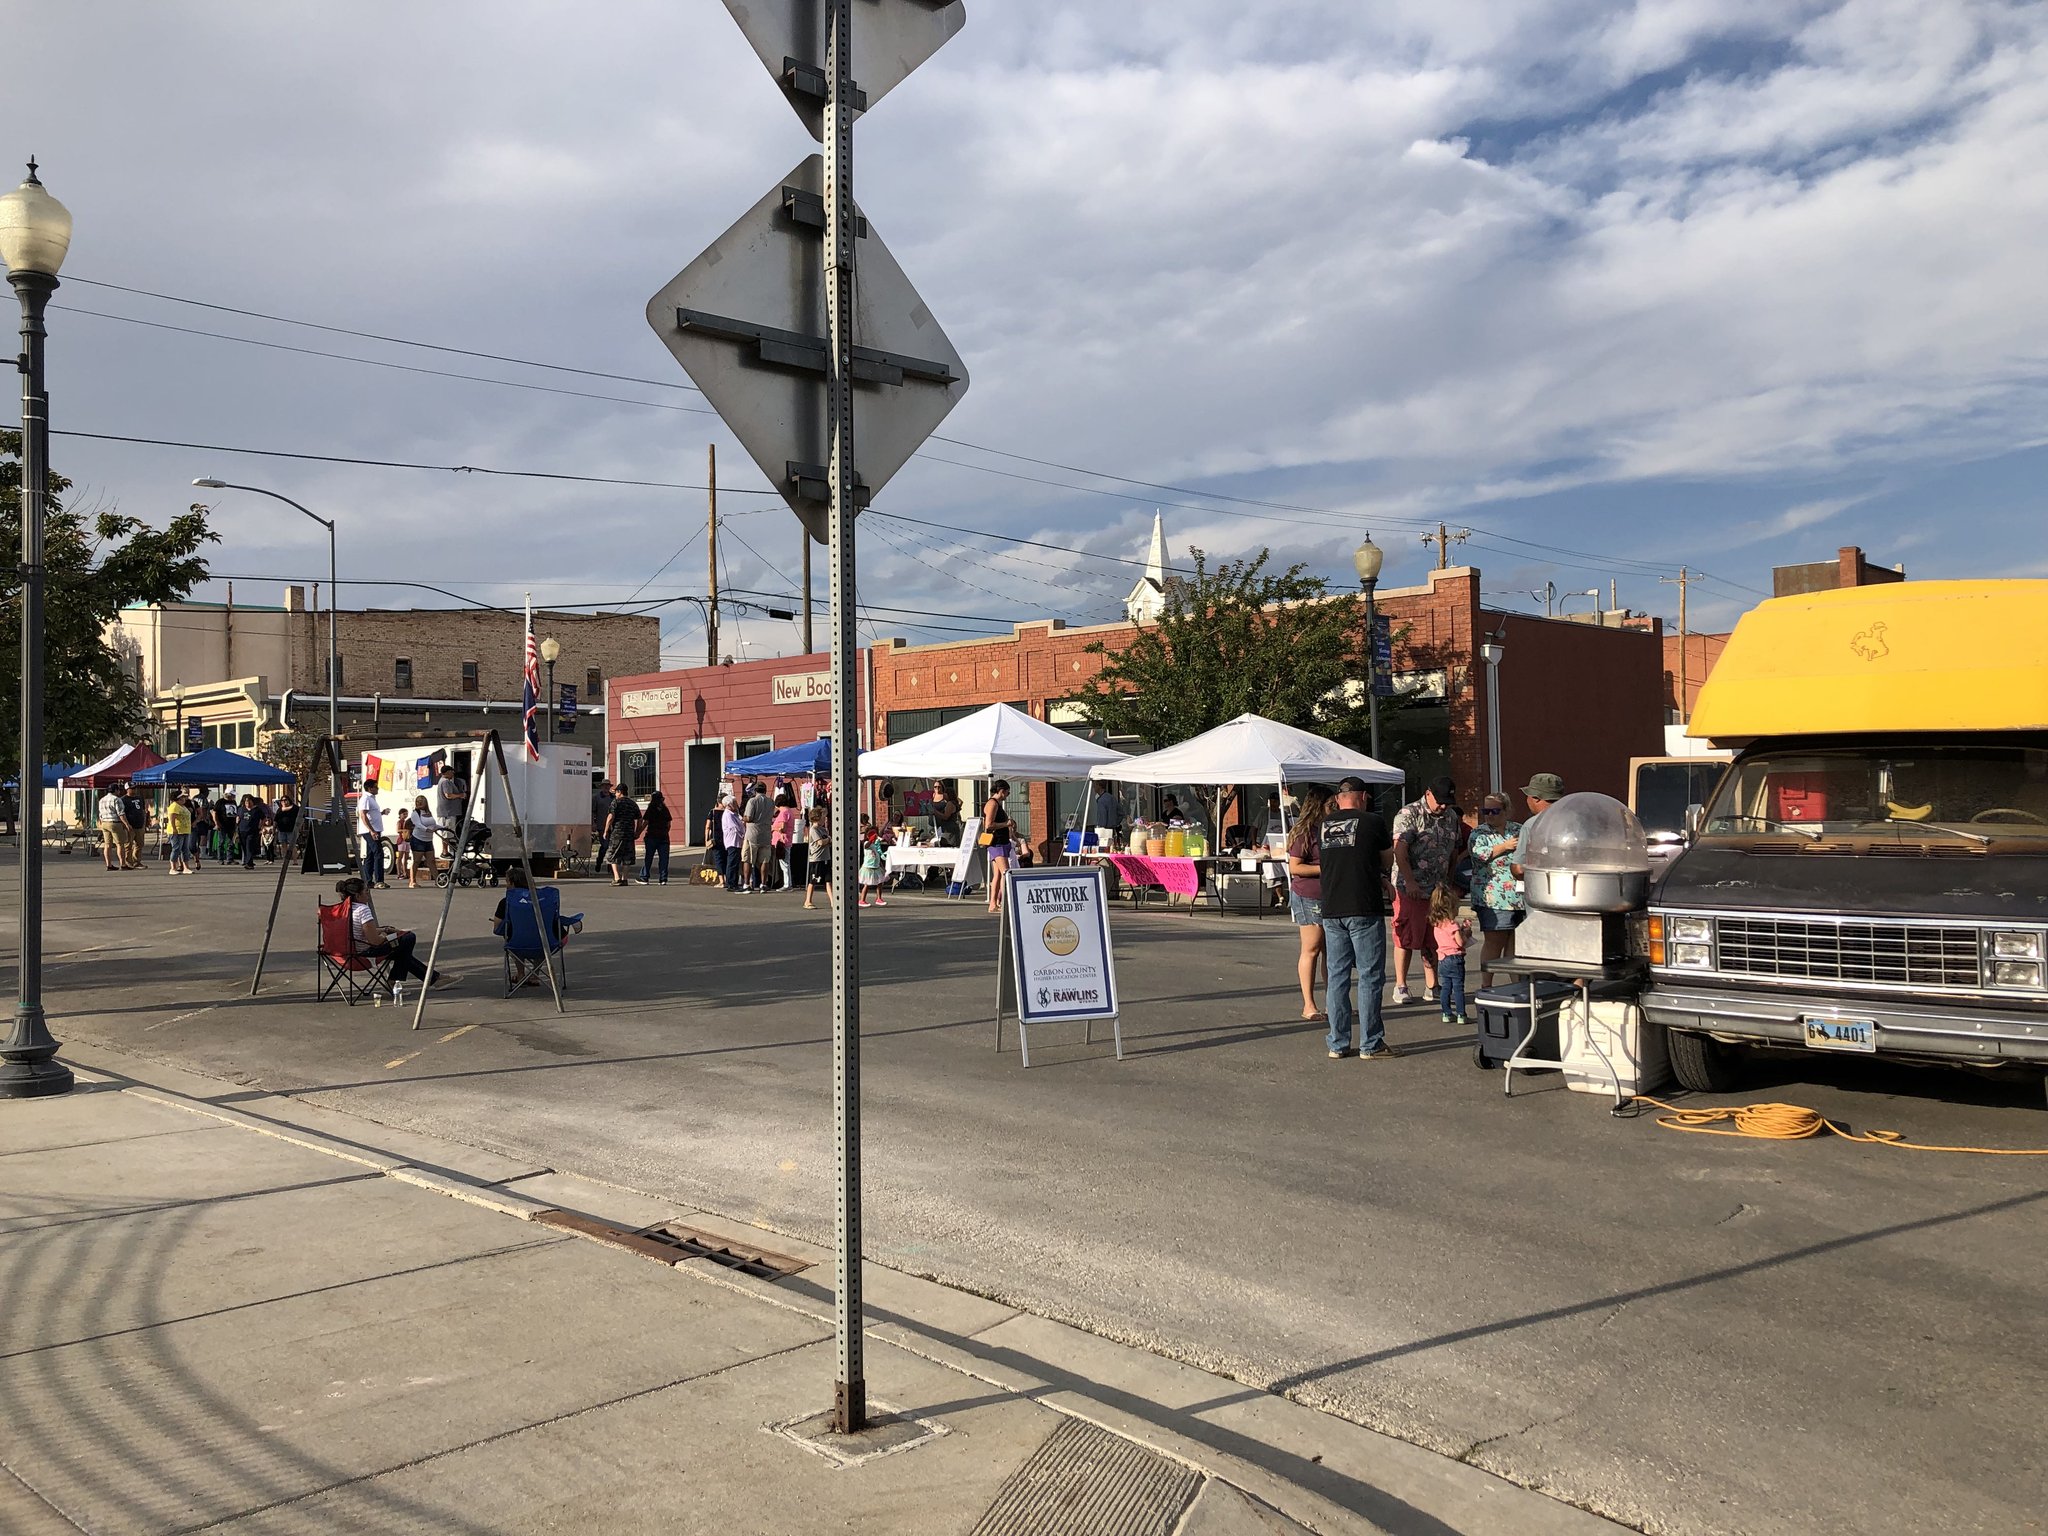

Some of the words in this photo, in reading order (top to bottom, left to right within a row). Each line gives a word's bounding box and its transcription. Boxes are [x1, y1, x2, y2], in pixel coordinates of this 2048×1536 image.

[777, 680, 801, 699] New
[806, 676, 831, 697] Boo
[641, 691, 659, 701] Man
[660, 690, 679, 700] Cave
[1027, 886, 1089, 904] ARTWORK
[1032, 903, 1073, 914] SPONSORED
[1074, 902, 1086, 912] BY:
[1053, 990, 1098, 1002] RAWLINS
[1808, 1024, 1816, 1039] 6
[1835, 1026, 1867, 1043] 4401
